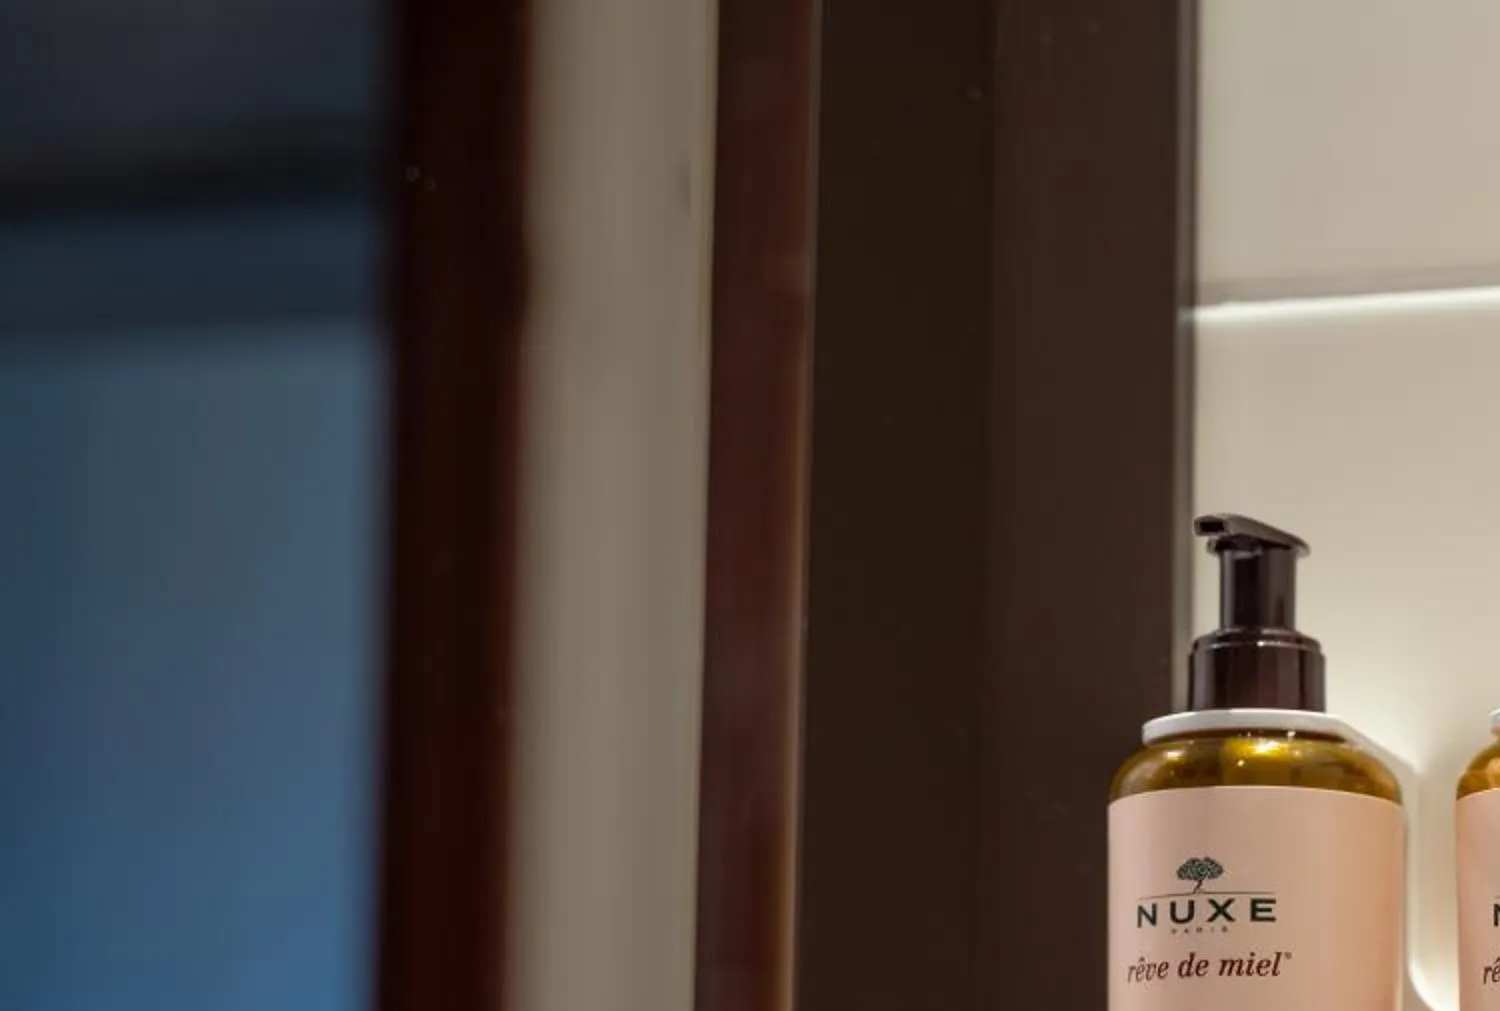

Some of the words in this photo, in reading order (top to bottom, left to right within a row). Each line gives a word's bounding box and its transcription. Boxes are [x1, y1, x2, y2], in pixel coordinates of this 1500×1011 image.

[1137, 899, 1276, 928] NUXE
[1127, 957, 1169, 983] rêve
[1178, 952, 1209, 977] de
